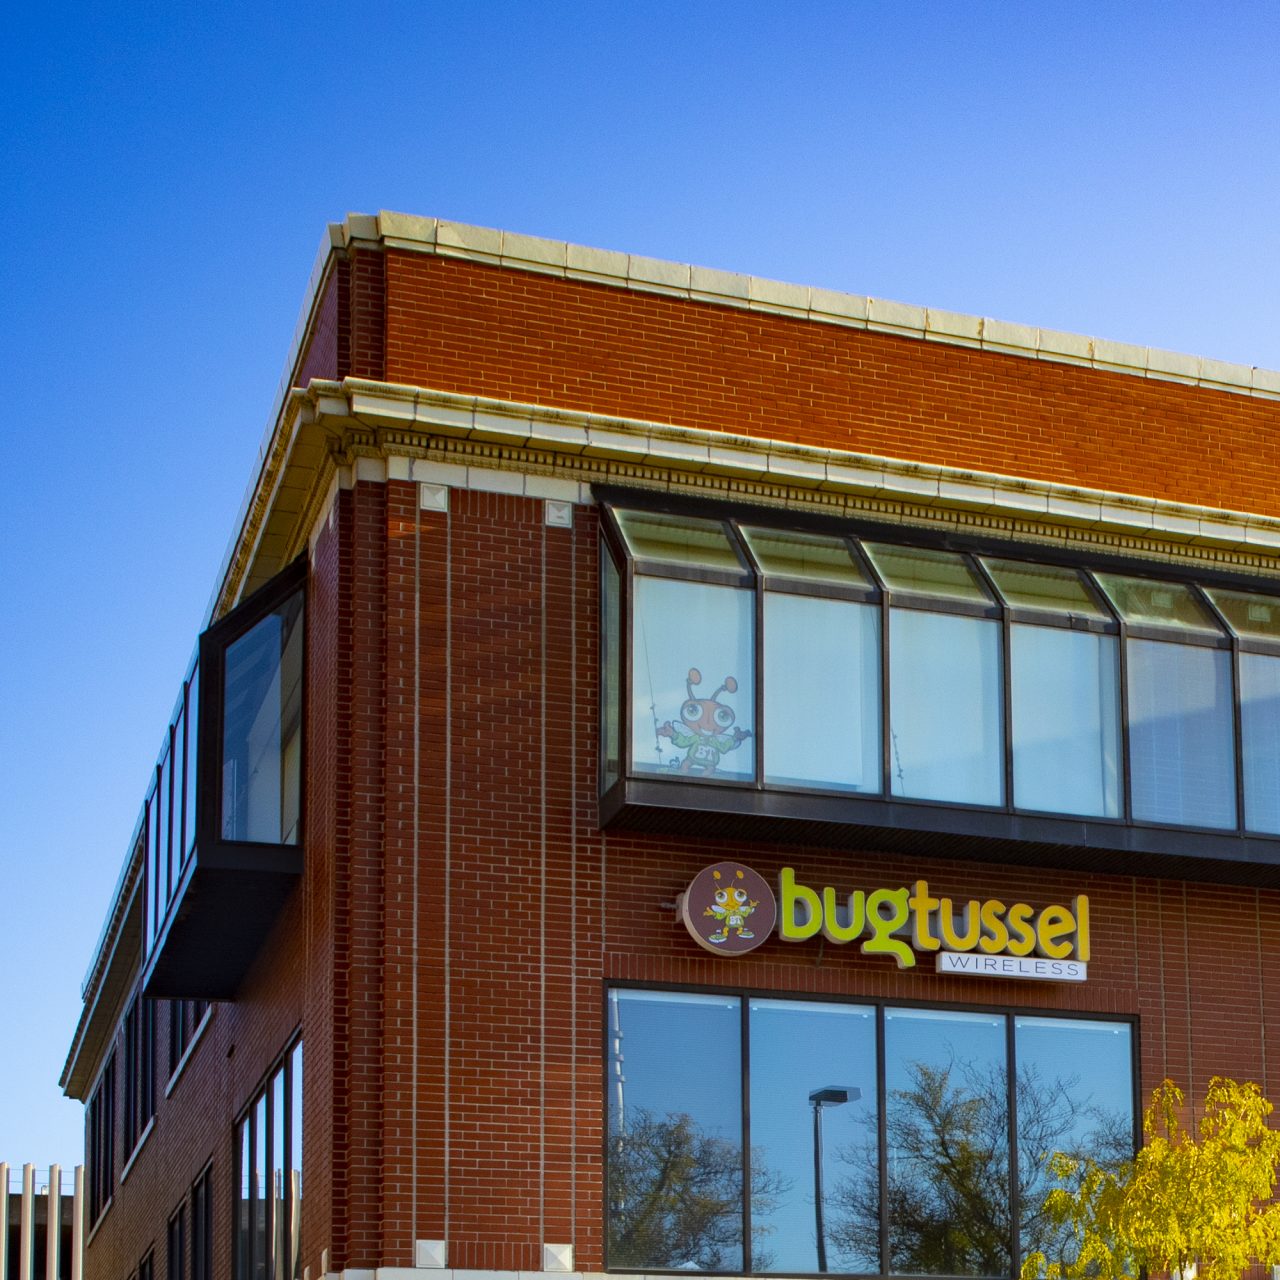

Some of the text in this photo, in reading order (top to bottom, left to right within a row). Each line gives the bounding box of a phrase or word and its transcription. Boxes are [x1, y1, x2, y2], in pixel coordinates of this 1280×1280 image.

[694, 745, 716, 760] BT
[780, 867, 1090, 969] bugtussel
[948, 956, 1079, 976] WIRELESS
